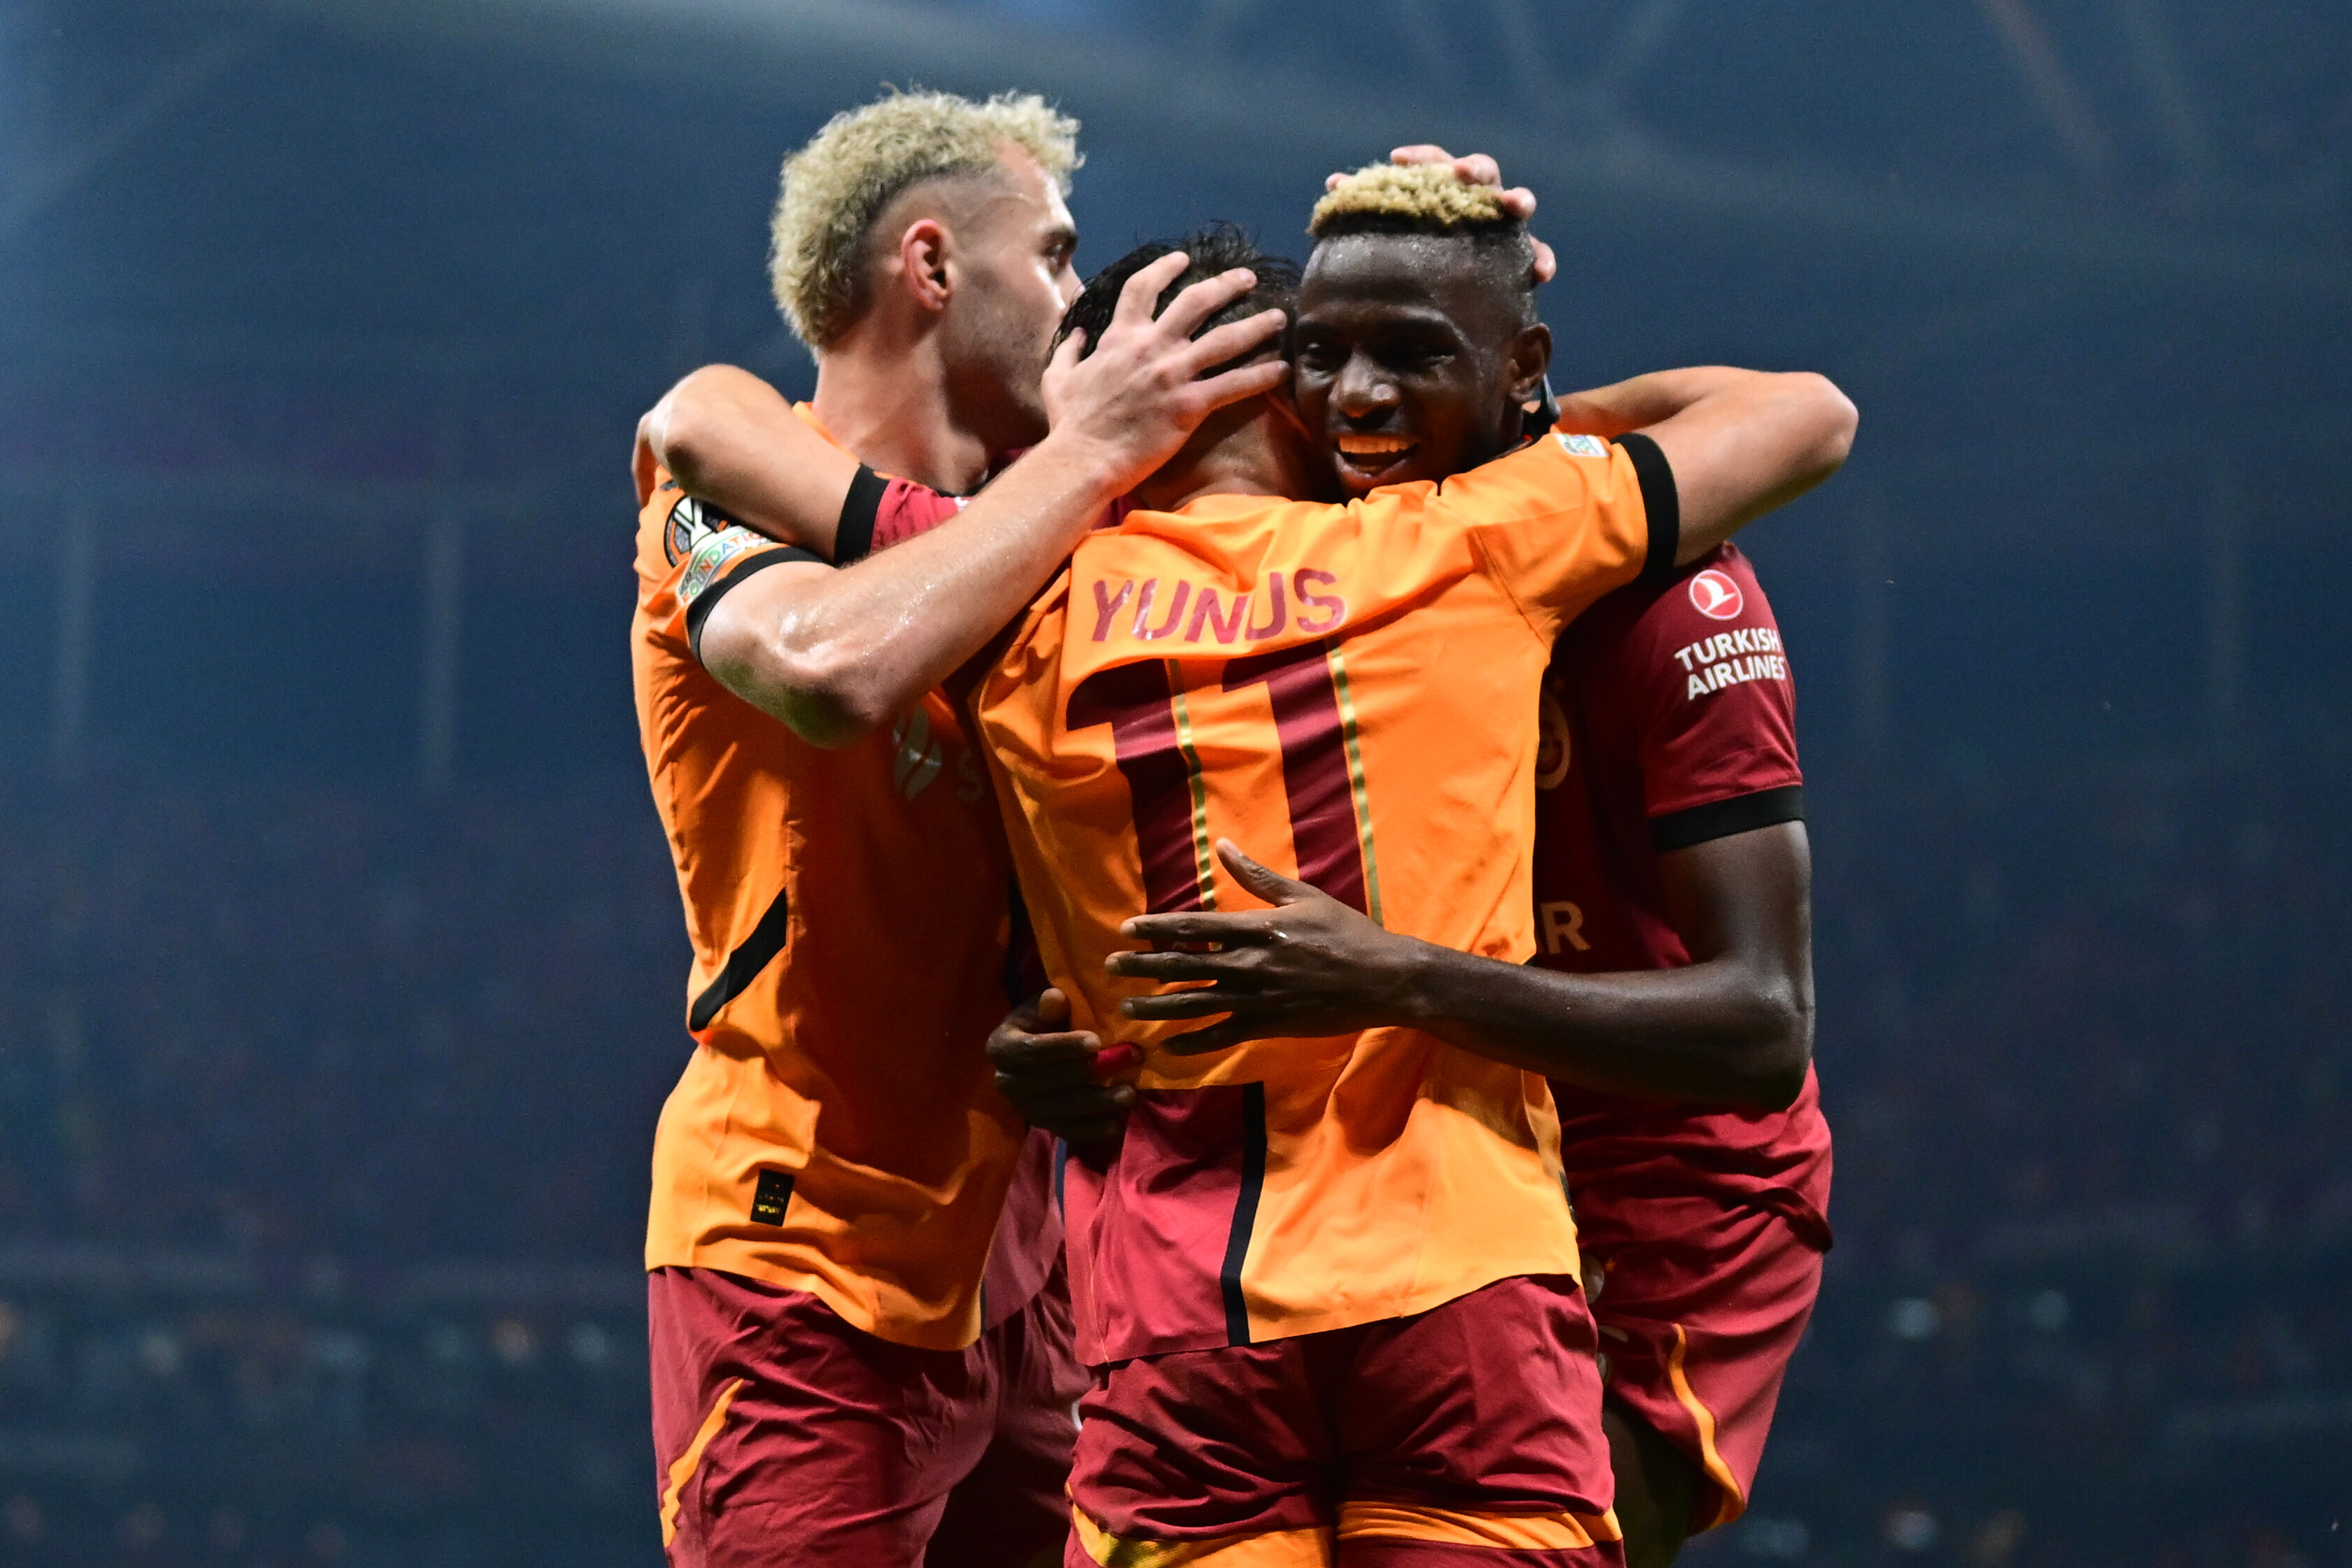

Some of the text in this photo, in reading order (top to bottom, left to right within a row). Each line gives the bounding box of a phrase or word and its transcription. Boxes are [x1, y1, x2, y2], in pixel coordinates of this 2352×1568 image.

[1092, 568, 1347, 644] YUNUS
[1674, 627, 1782, 672] TURKISH
[1688, 654, 1786, 700] AIRLINES
[1066, 634, 1385, 982] 11
